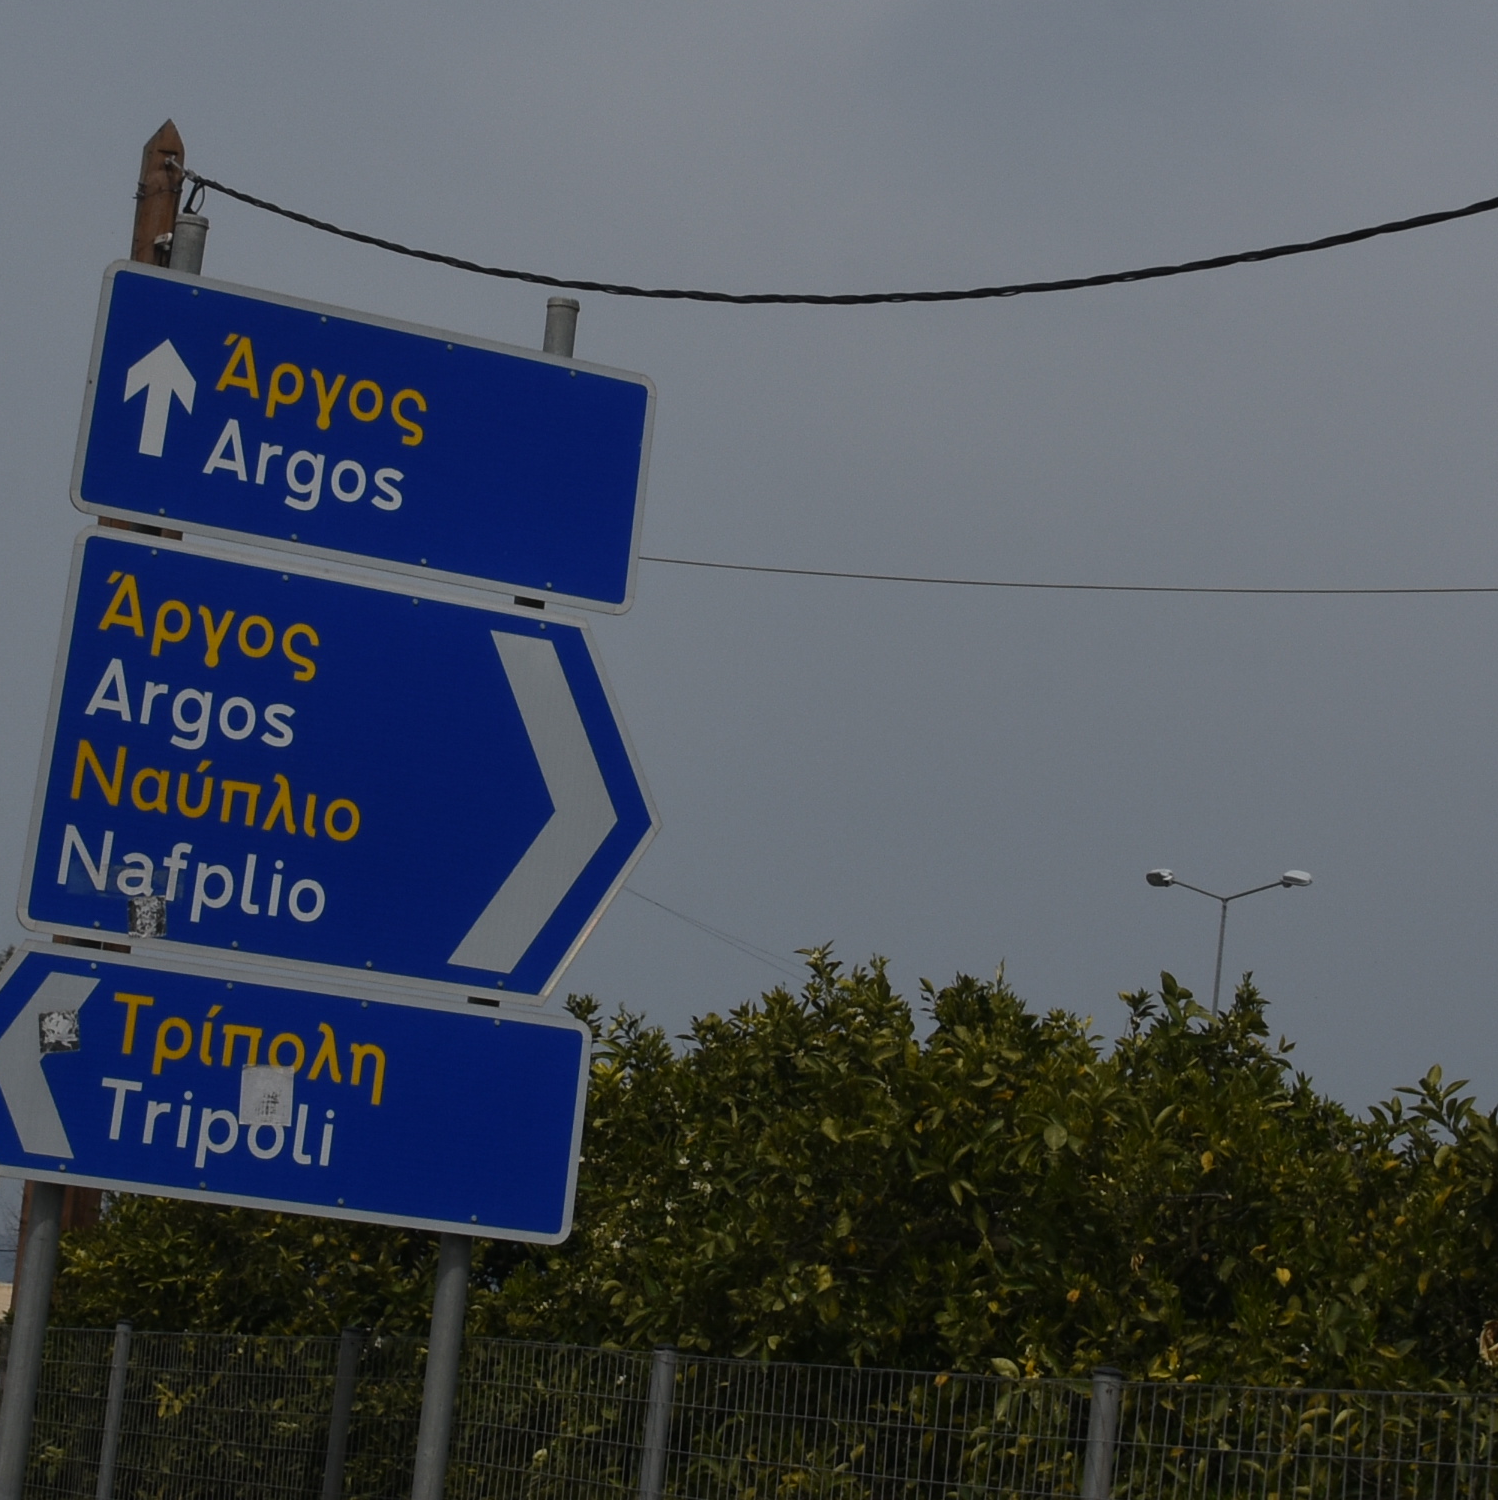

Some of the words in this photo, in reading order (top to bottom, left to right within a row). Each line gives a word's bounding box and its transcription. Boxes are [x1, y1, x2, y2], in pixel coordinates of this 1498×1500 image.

[215, 334, 428, 447] Άργος
[203, 419, 404, 511] Argos
[98, 571, 320, 682] Άργος
[85, 659, 295, 750] Argos
[71, 739, 361, 842] Ναύπλιο
[57, 824, 326, 923] Nafplio
[113, 992, 386, 1106] Τρίπολη
[101, 1077, 335, 1168] Tripoli
